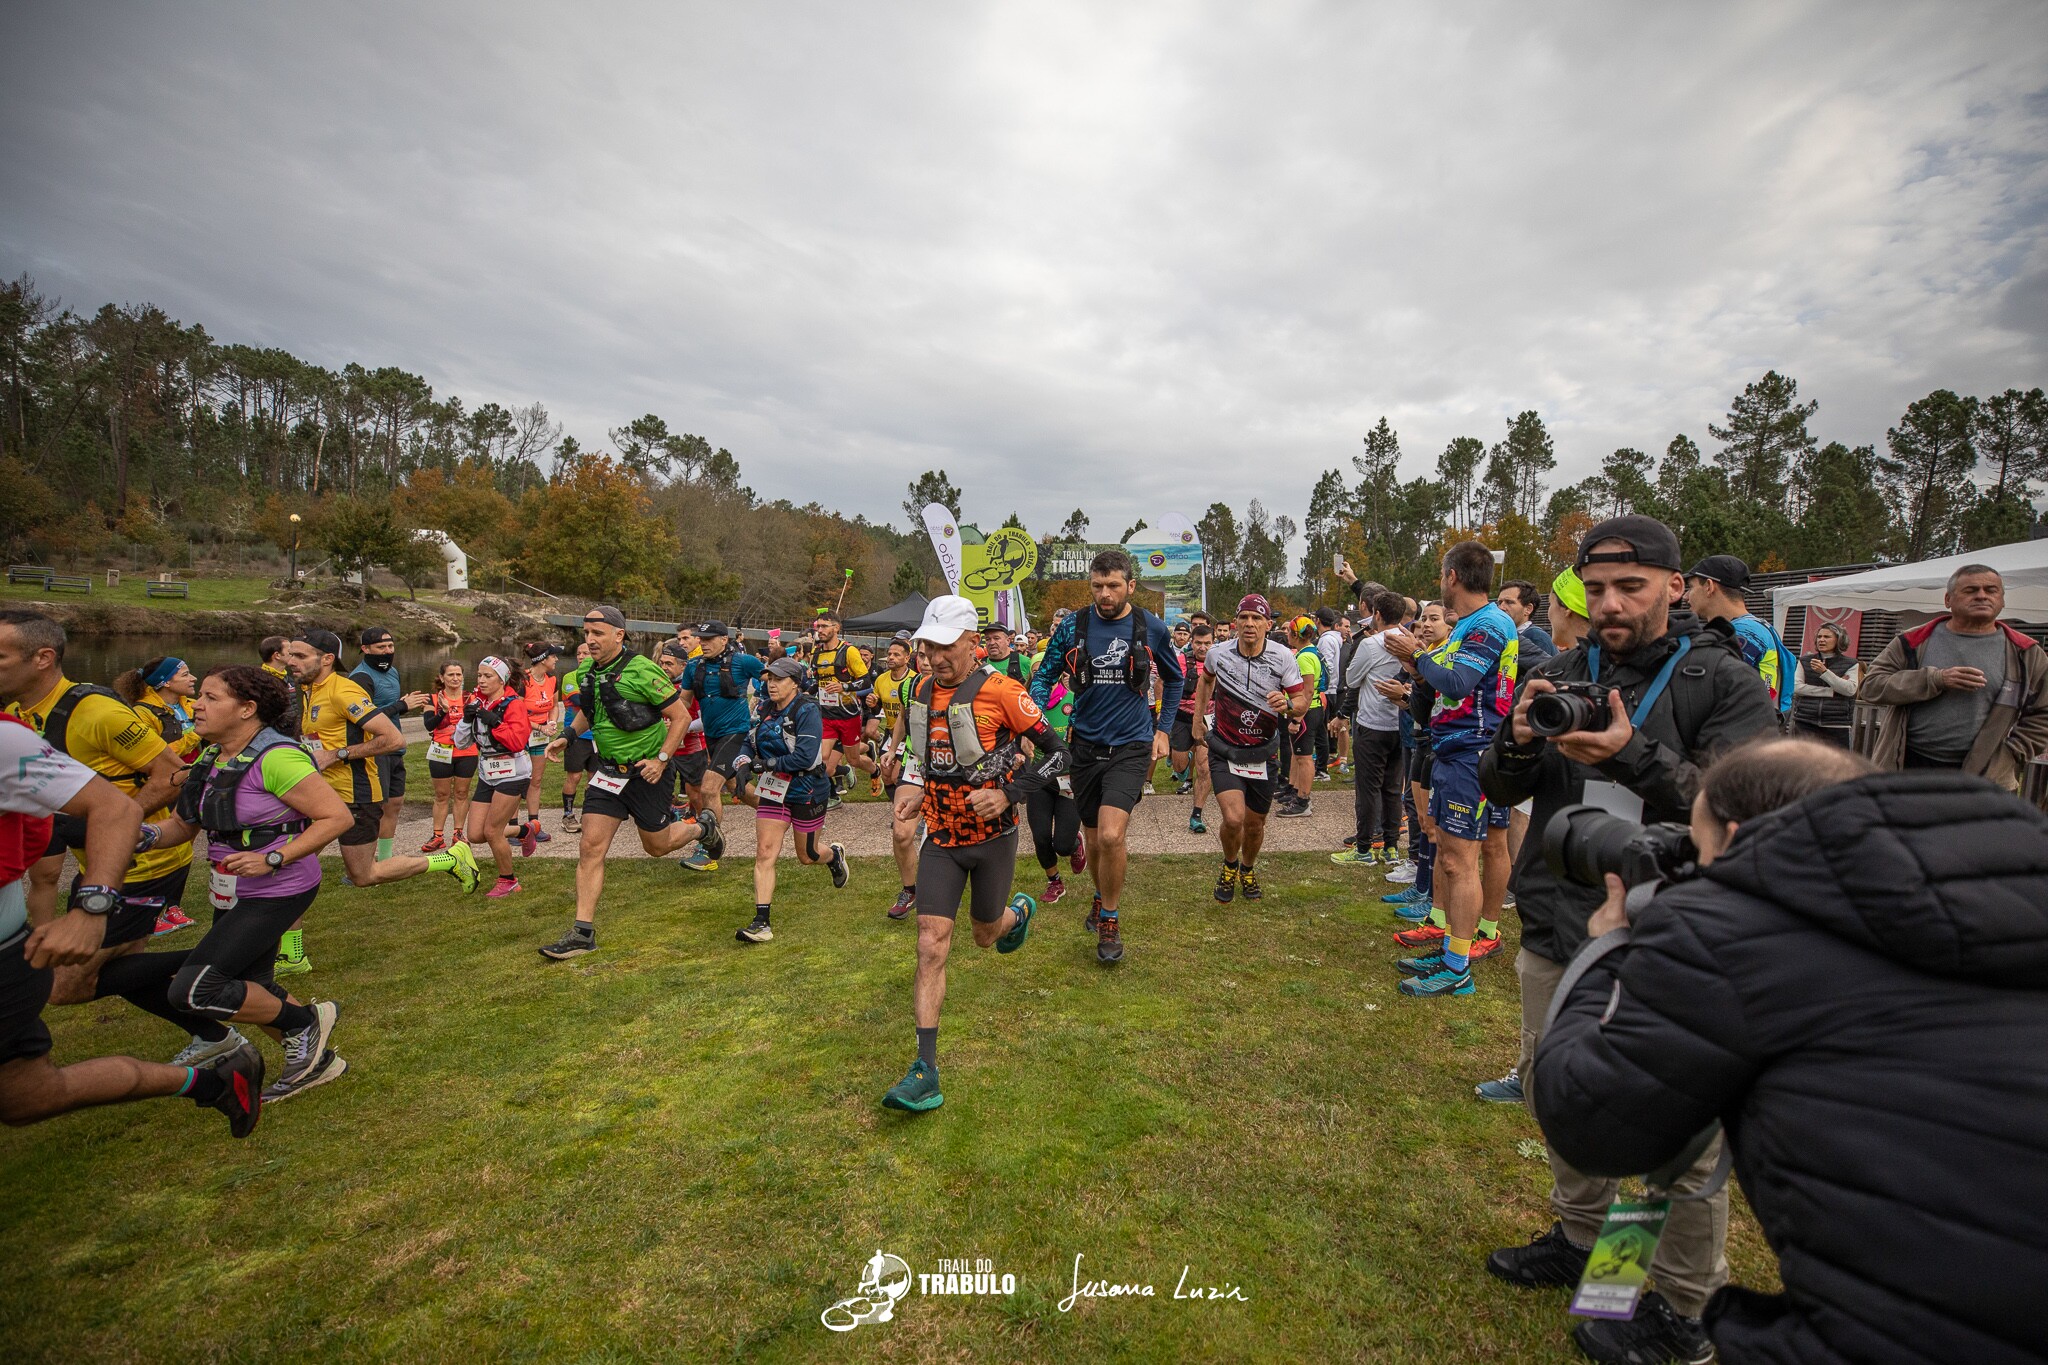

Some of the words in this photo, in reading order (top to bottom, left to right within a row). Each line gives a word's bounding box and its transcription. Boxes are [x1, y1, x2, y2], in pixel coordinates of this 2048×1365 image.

[1063, 550, 1083, 560] TRAIL
[1085, 550, 1096, 560] DO
[1238, 727, 1263, 735] CIMD
[489, 761, 500, 769] 168
[764, 776, 775, 786] 167
